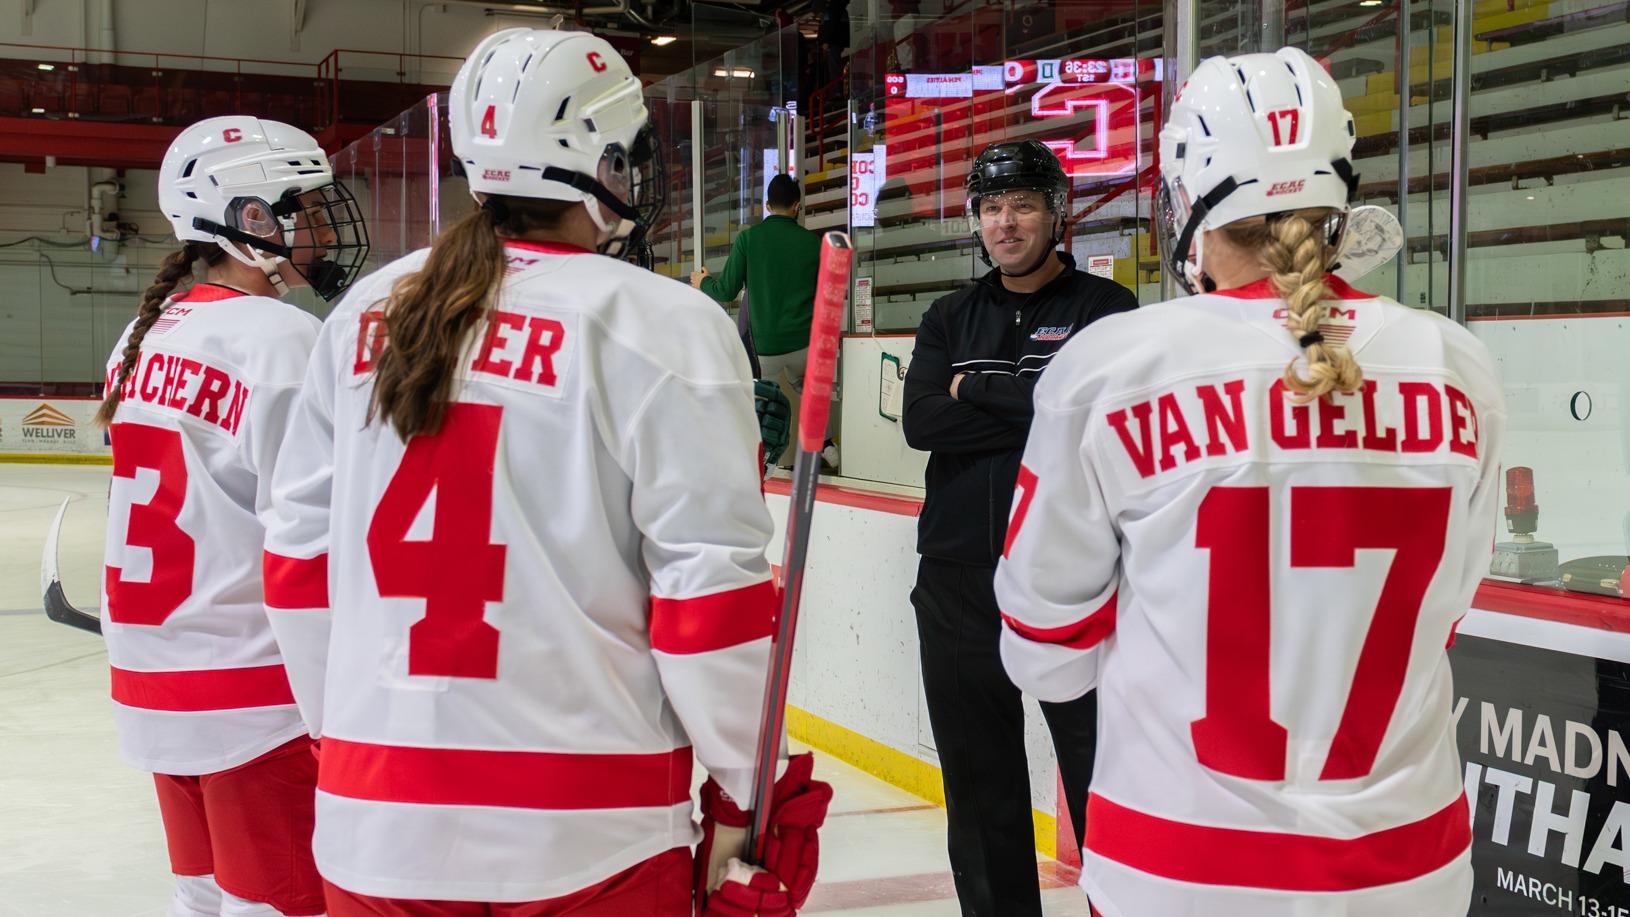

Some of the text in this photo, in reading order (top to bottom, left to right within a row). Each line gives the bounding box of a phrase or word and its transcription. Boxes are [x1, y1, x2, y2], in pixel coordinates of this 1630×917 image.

[586, 52, 607, 73] C
[222, 128, 242, 143] C
[481, 105, 497, 139] 4
[1267, 108, 1299, 146] 17
[1271, 180, 1306, 190] ECAC
[162, 307, 192, 316] CM
[22, 427, 76, 439] WELLIVER
[1106, 378, 1479, 479] VAN GELDE
[367, 403, 507, 679] 4
[1190, 486, 1453, 782] 17
[1497, 867, 1573, 912] MARCH
